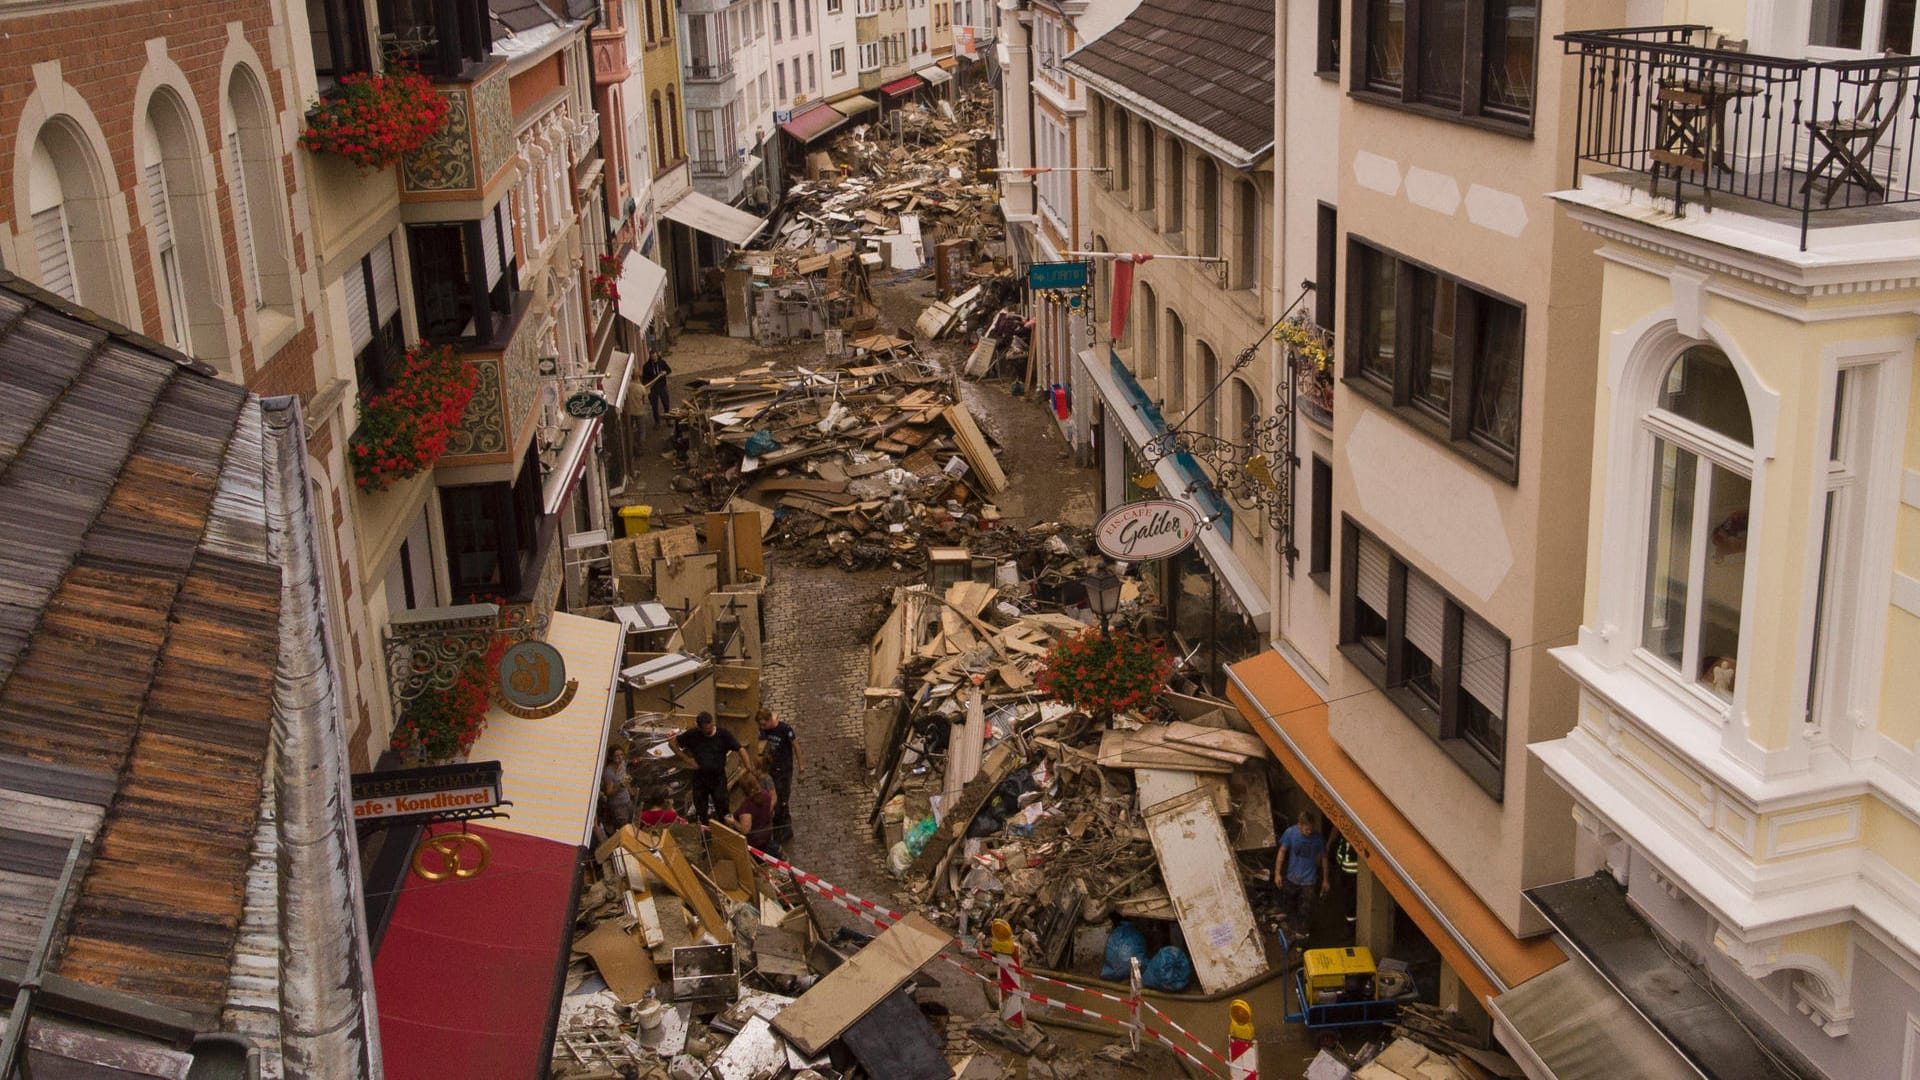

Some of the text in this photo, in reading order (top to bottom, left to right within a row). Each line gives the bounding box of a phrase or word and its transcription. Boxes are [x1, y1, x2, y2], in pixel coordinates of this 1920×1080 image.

[1119, 510, 1180, 555] Galileo
[353, 789, 489, 816] afe Konditorei
